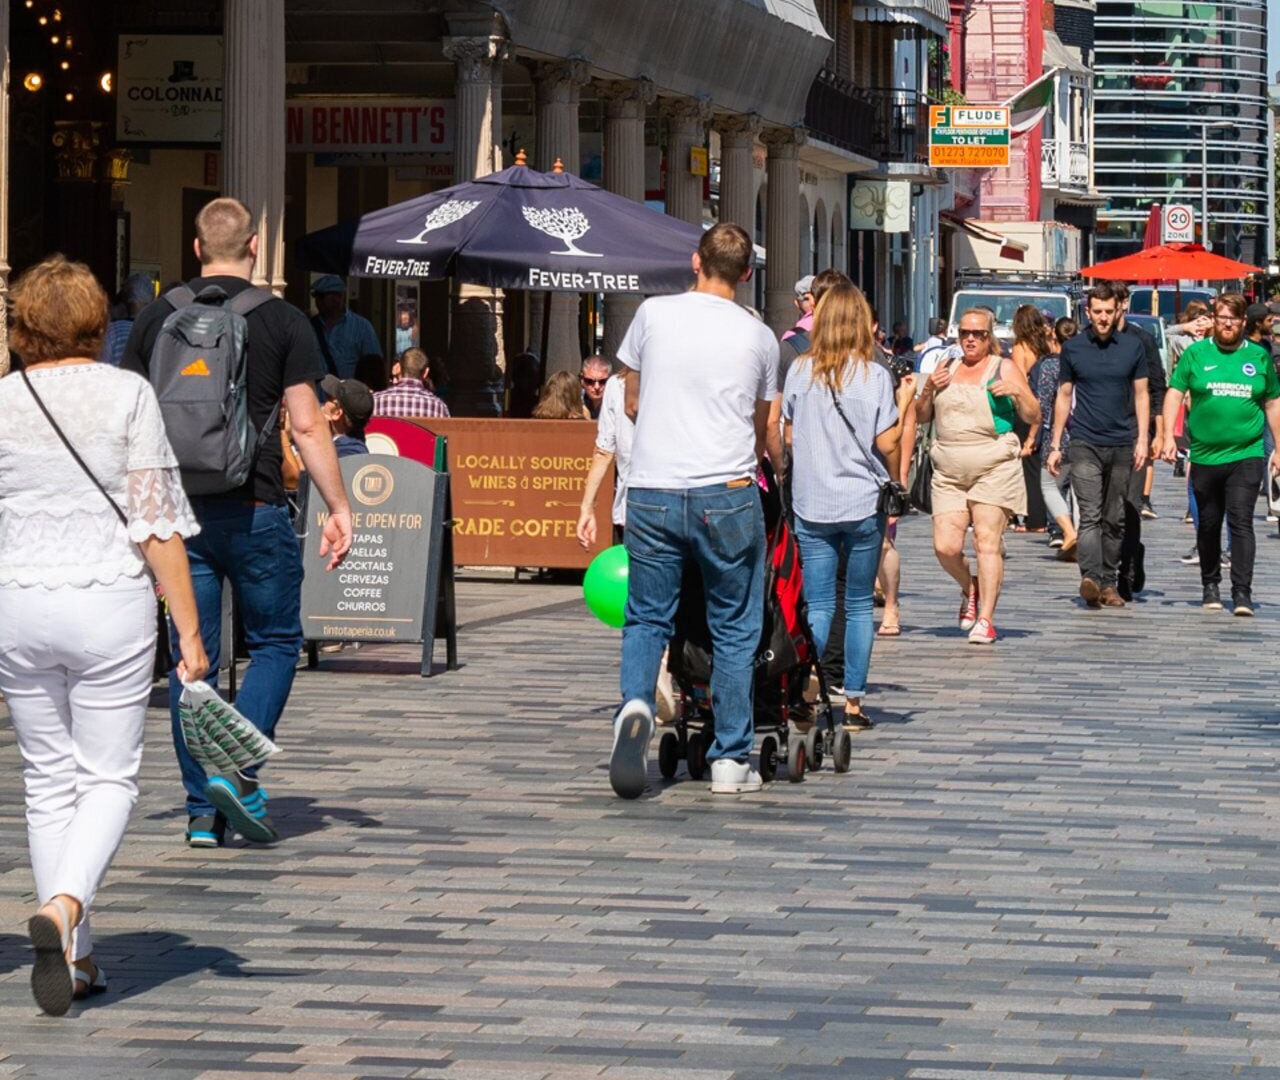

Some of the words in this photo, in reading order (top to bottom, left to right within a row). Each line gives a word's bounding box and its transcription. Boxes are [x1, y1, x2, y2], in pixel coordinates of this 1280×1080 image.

[958, 110, 1001, 120] FLUDE
[312, 106, 445, 144] BENNETT'S
[951, 136, 965, 144] TO
[967, 136, 986, 144] LET
[934, 147, 965, 157] 01273
[967, 147, 1005, 157] 727070
[1171, 213, 1187, 224] 20
[365, 256, 430, 277] FEVER-TREE
[529, 268, 640, 290] FEVER-TREE
[1206, 382, 1252, 392] AMERICAN
[1212, 389, 1252, 398] EXPRESS
[457, 455, 526, 470] LOCALLY
[469, 475, 517, 490] WINES
[366, 513, 396, 529] OPEN
[399, 514, 422, 530] FOR
[353, 533, 384, 544] TAPAS
[337, 560, 394, 571] COCKTAILS
[338, 574, 389, 585] CERVEZAS
[343, 587, 382, 598] COFFEE
[336, 601, 386, 612] CHURROS
